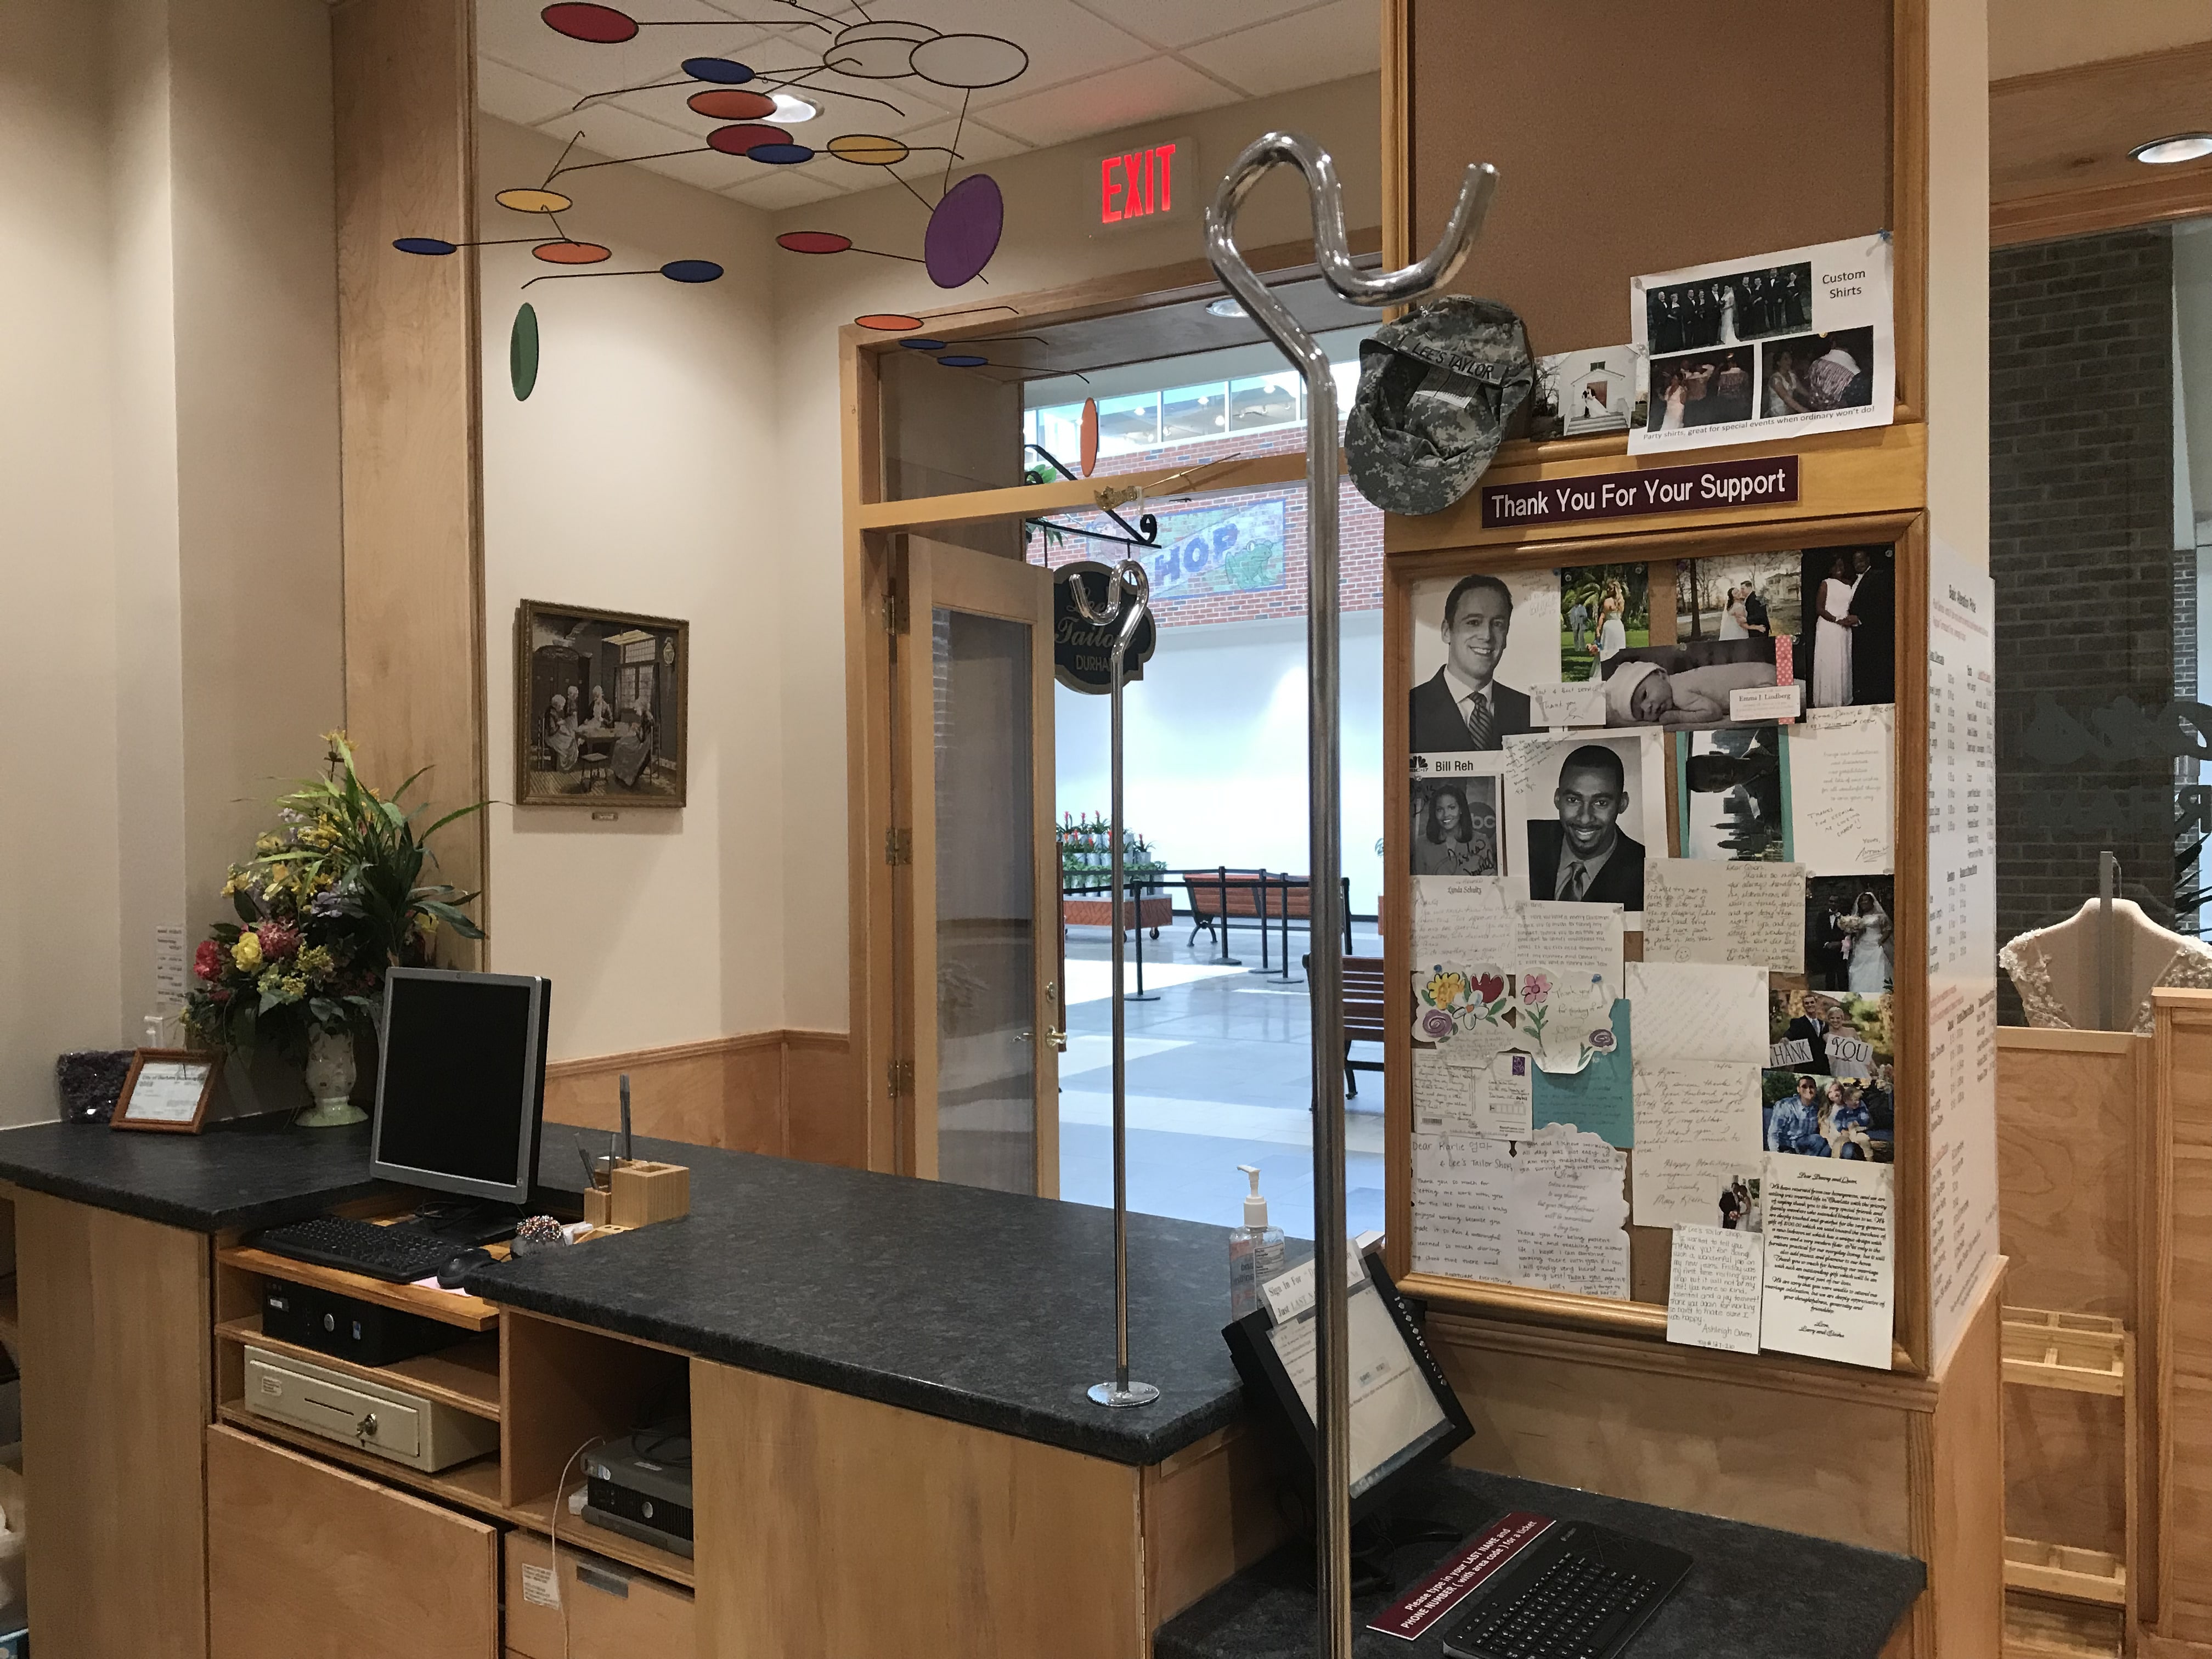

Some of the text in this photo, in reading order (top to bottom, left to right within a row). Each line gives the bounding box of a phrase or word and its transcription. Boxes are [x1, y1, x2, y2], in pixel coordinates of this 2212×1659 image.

[1102, 144, 1176, 224] EXIT
[1822, 270, 1866, 284] Custom
[1830, 286, 1862, 299] Shirts
[1448, 353, 1494, 380] TAYLOR
[1688, 427, 1707, 436] great
[1722, 422, 1747, 431] special
[1750, 419, 1774, 427] events
[1800, 413, 1833, 421] ordinary
[1836, 408, 1859, 417] won't
[1492, 469, 1786, 518] Thank You For Your Support
[1155, 523, 1239, 586] HOP
[1075, 654, 1111, 672] DURHA
[1436, 760, 1474, 772] Bill Reh
[1448, 886, 1482, 895] Lynda Schultz
[1832, 1036, 1869, 1063] YOU
[1412, 1142, 1432, 1150] Dear
[1449, 1159, 1466, 1167] Lee's
[1470, 1159, 1492, 1167] Tailor
[1567, 1234, 1585, 1243] being
[1698, 1254, 1732, 1263] wonderful
[1268, 1276, 1302, 1297] Sign In For
[1277, 1305, 1290, 1317] Just
[1290, 1295, 1307, 1310] LAST
[1702, 1323, 1733, 1339] Ashleigh
[1400, 1607, 1429, 1629] PHONE
[1424, 1586, 1457, 1609] NUMBER
[1458, 1571, 1476, 1583] with
[1472, 1560, 1489, 1572] area
[1486, 1548, 1504, 1560] code
[1502, 1537, 1516, 1545] for
[1516, 1520, 1537, 1534] ticket
[1404, 1591, 1432, 1611] Please
[1426, 1581, 1446, 1594] type
[1450, 1563, 1467, 1577] your
[1462, 1550, 1482, 1565] LAST
[1478, 1537, 1500, 1552] NAME
[1497, 1528, 1511, 1538] and
